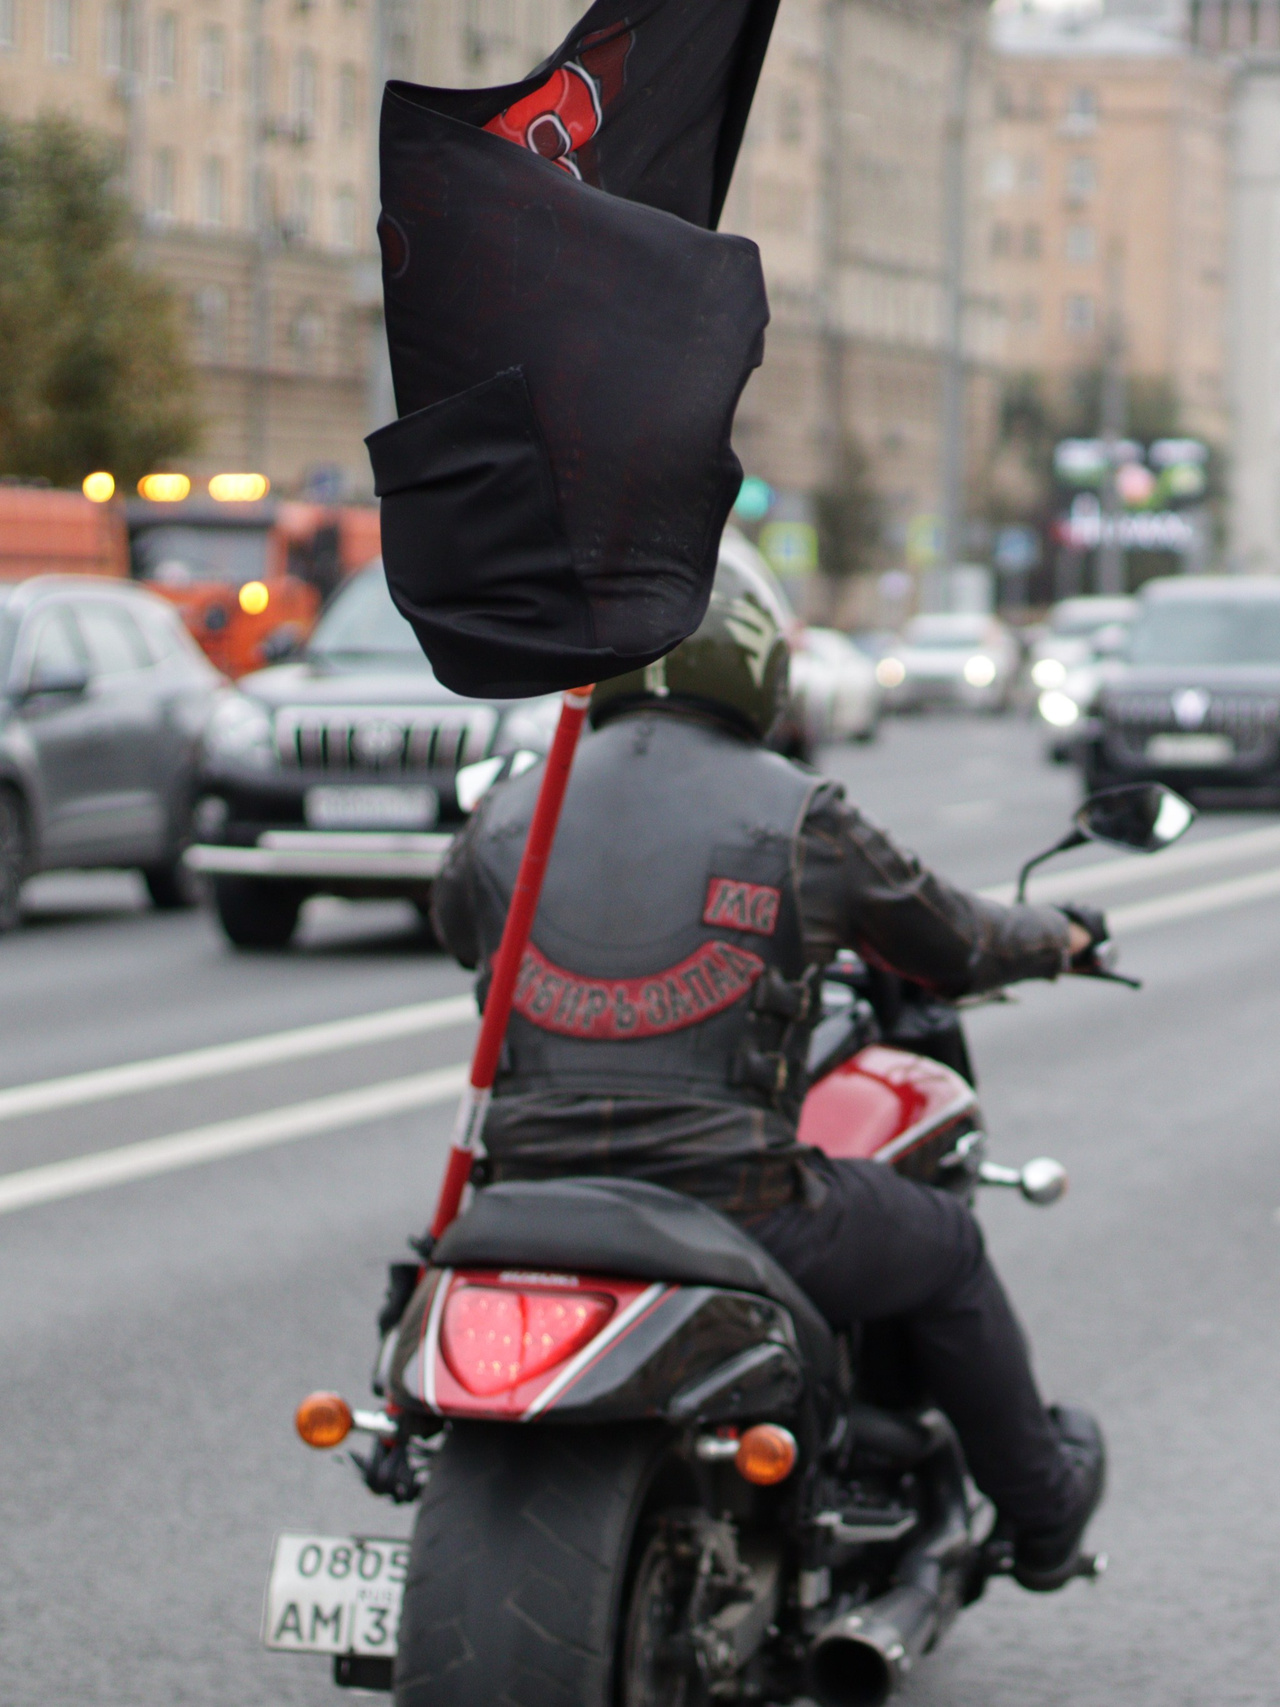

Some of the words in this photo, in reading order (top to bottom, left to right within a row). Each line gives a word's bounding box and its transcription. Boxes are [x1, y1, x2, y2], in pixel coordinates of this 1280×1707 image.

[513, 952, 638, 1031] ИБИРЬ
[297, 1543, 409, 1582] 0805
[363, 1606, 400, 1647] 3
